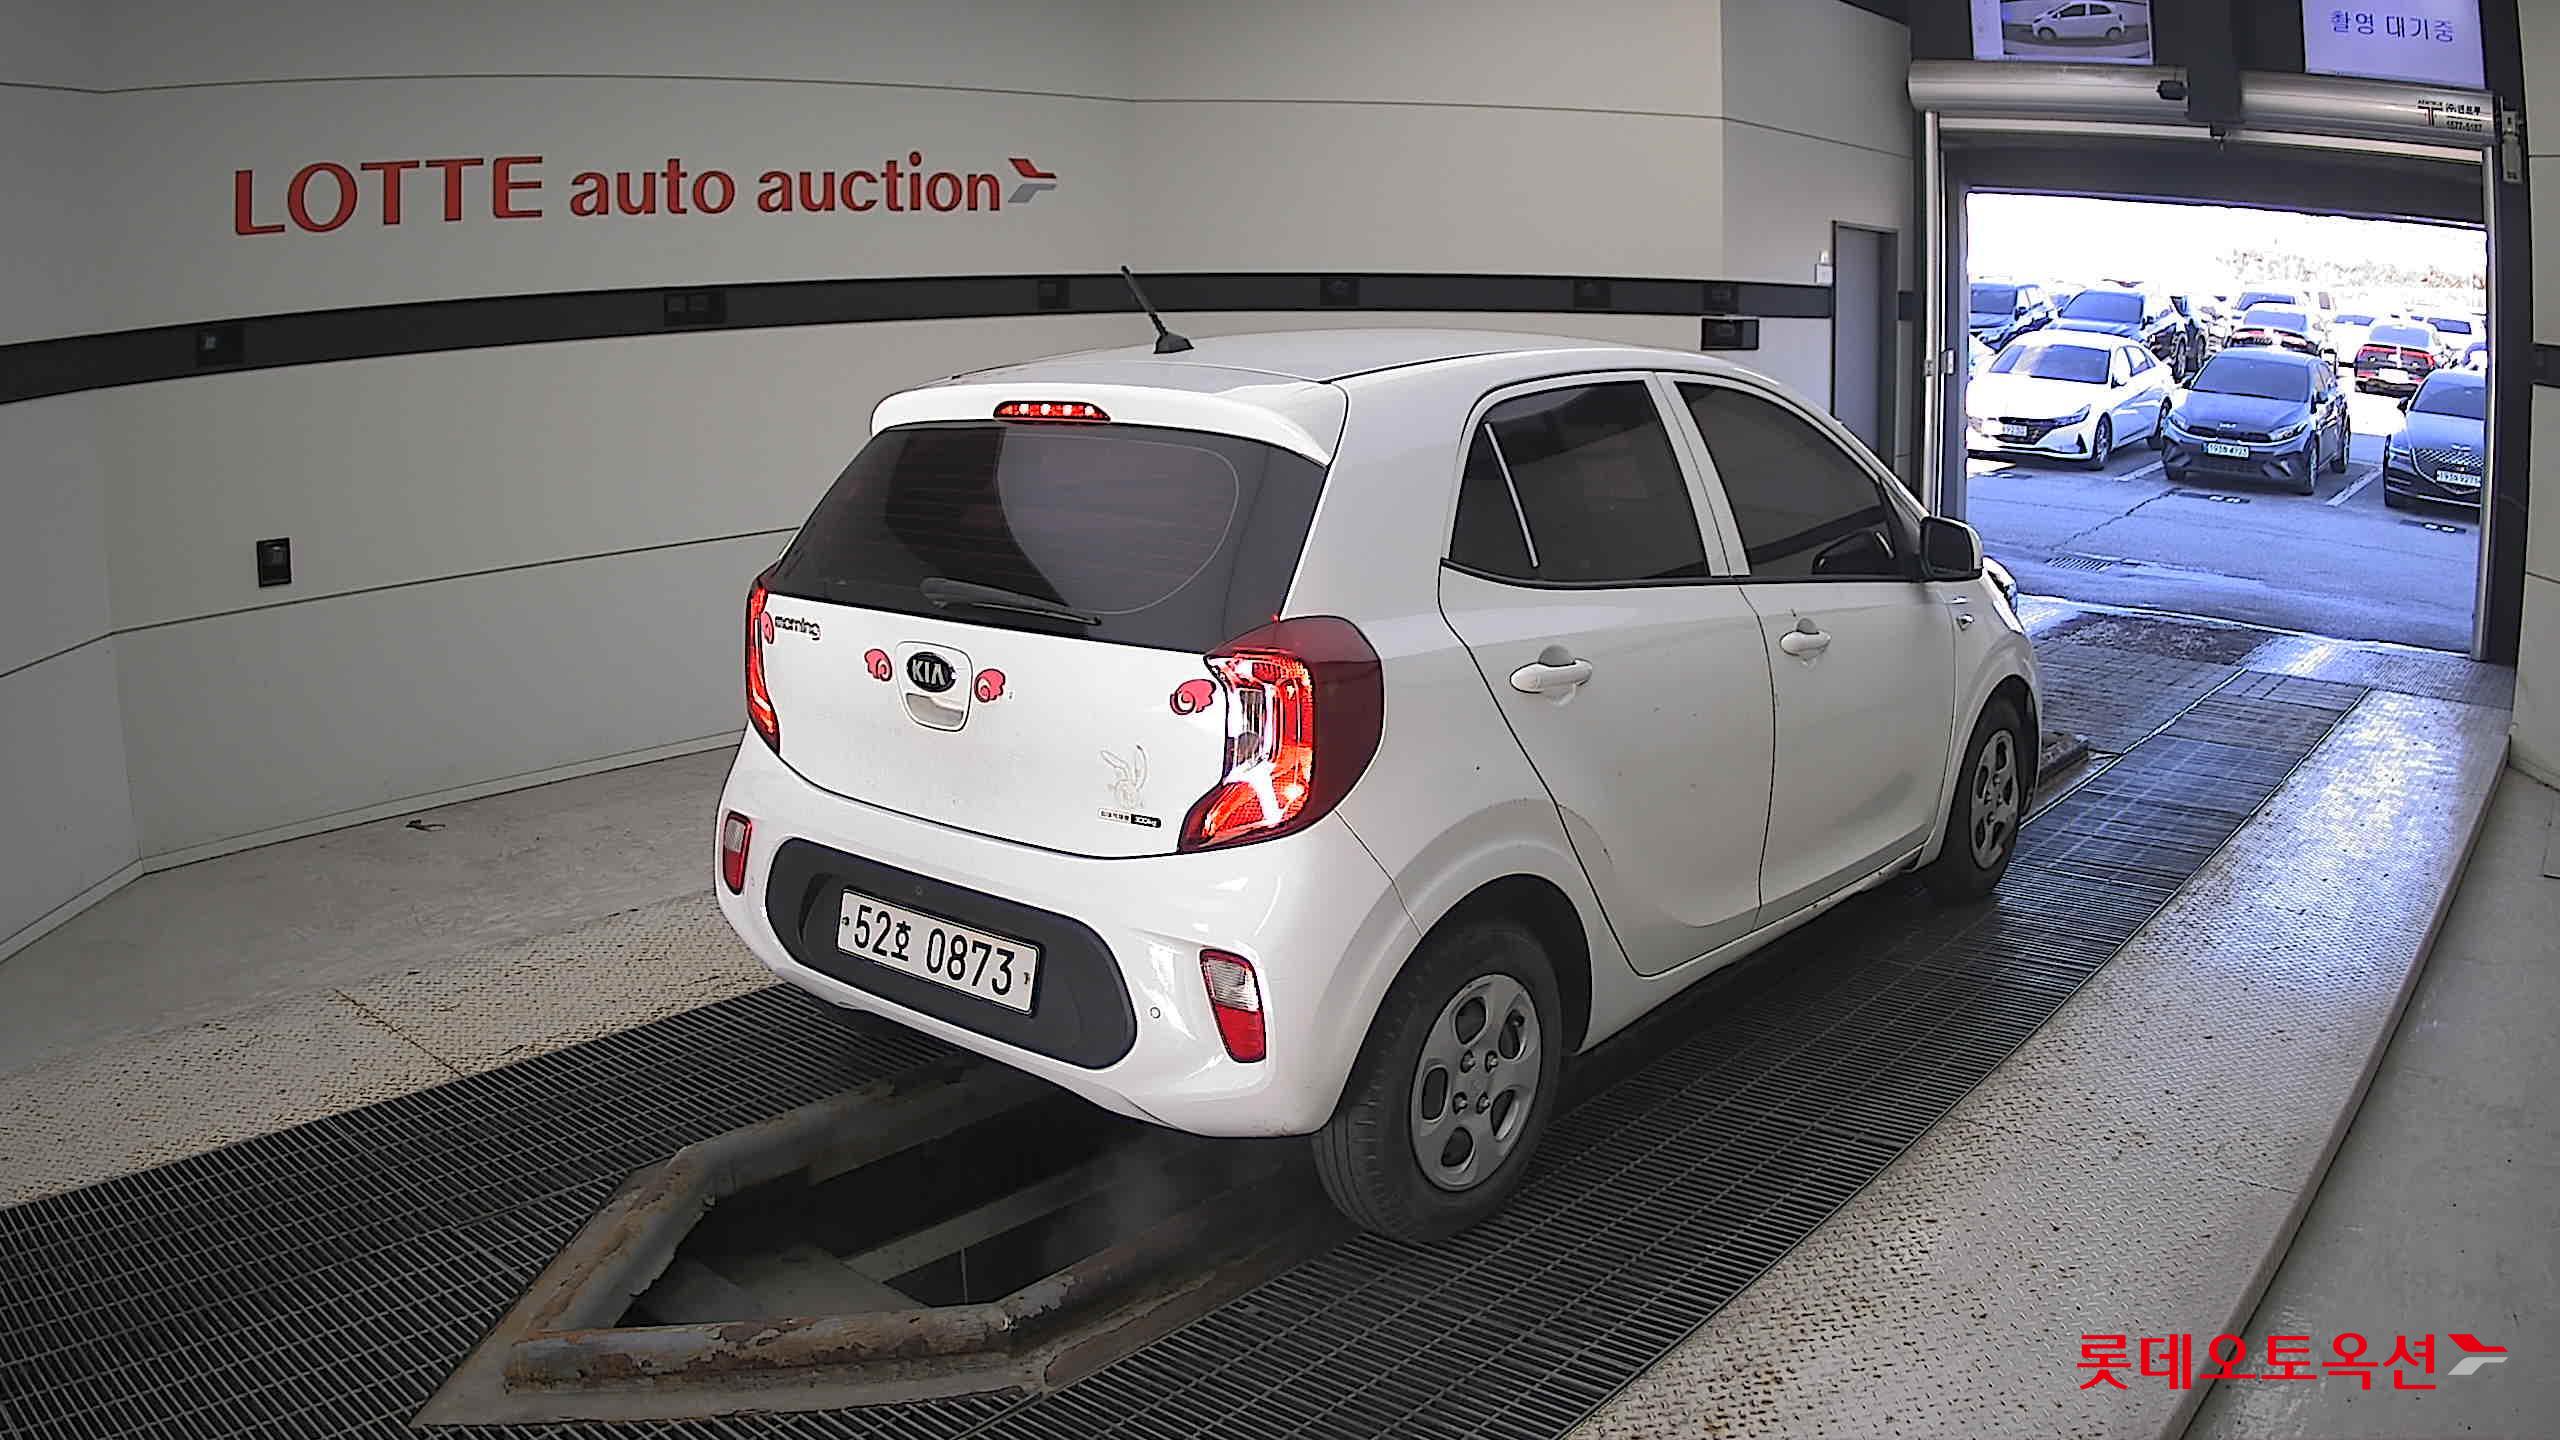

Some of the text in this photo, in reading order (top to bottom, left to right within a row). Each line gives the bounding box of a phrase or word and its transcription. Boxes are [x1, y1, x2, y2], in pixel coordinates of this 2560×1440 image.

[2331, 10, 2454, 42] 촬영 대기중
[233, 150, 1002, 236] LOTTE auto auction
[911, 659, 946, 686] KIA
[853, 904, 1016, 996] 52호 0873
